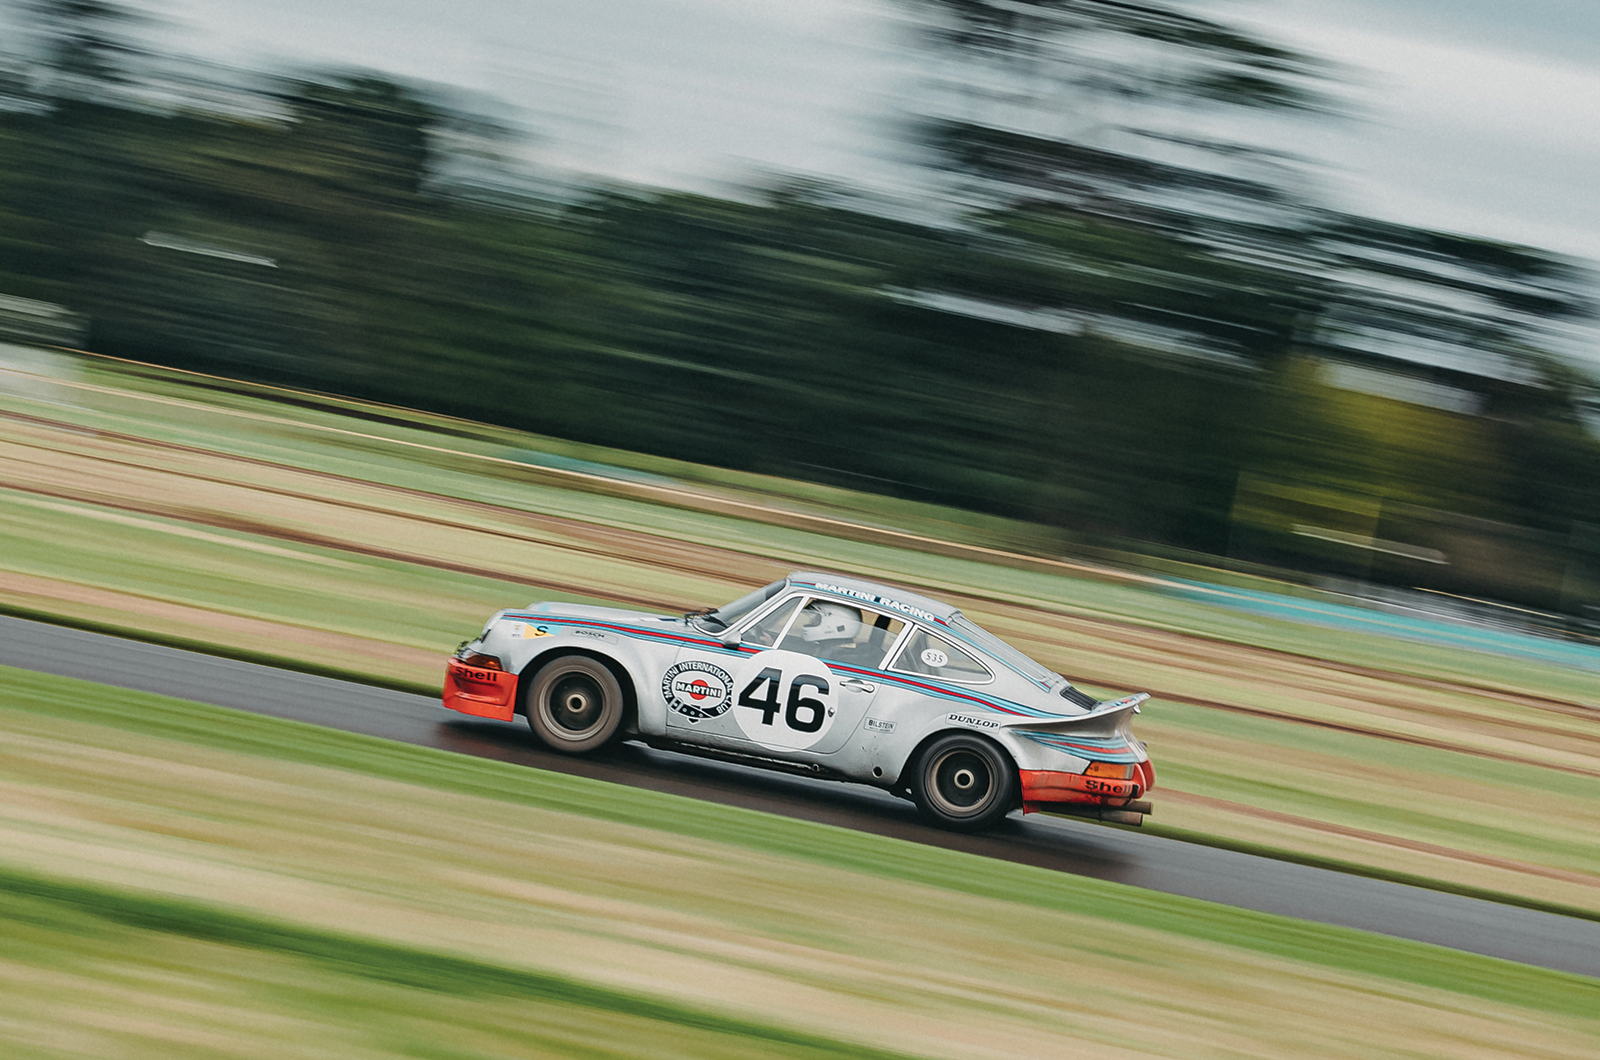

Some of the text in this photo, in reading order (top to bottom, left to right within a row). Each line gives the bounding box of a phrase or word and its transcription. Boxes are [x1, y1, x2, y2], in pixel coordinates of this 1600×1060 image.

[815, 582, 935, 622] MARTINI RACING
[455, 666, 497, 682] Shell
[662, 661, 733, 714] MARTINI INTERNATIONAL CLUB
[676, 682, 722, 697] MARTINI
[738, 666, 830, 734] 46
[868, 719, 895, 729] BILSTEIN
[948, 714, 999, 728] DUNLOP
[1085, 780, 1131, 795] Shell
